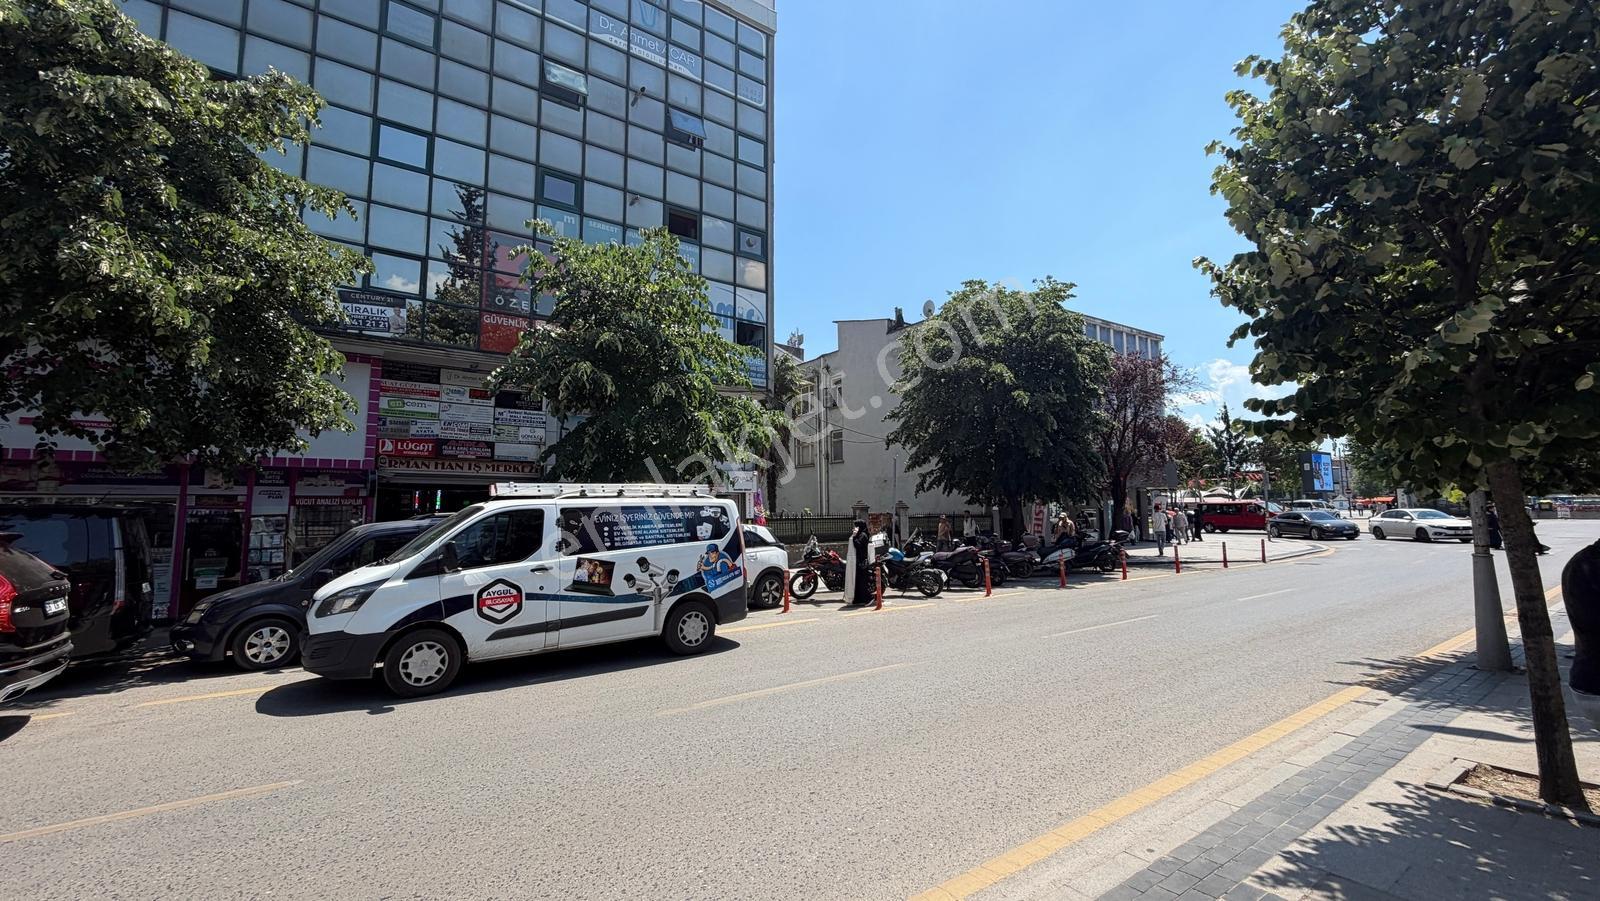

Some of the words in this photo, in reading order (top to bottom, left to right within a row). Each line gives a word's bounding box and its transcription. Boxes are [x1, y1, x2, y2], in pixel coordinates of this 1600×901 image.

[599, 15, 616, 33] Dr.
[588, 221, 618, 233] SERBEST
[351, 293, 386, 302] CENTURY
[495, 294, 540, 312] ÖZEL
[343, 304, 387, 316] KİRALIK
[483, 314, 529, 329] GÜVENLİK
[434, 460, 464, 471] HAN
[486, 589, 513, 597] AYGÜL
